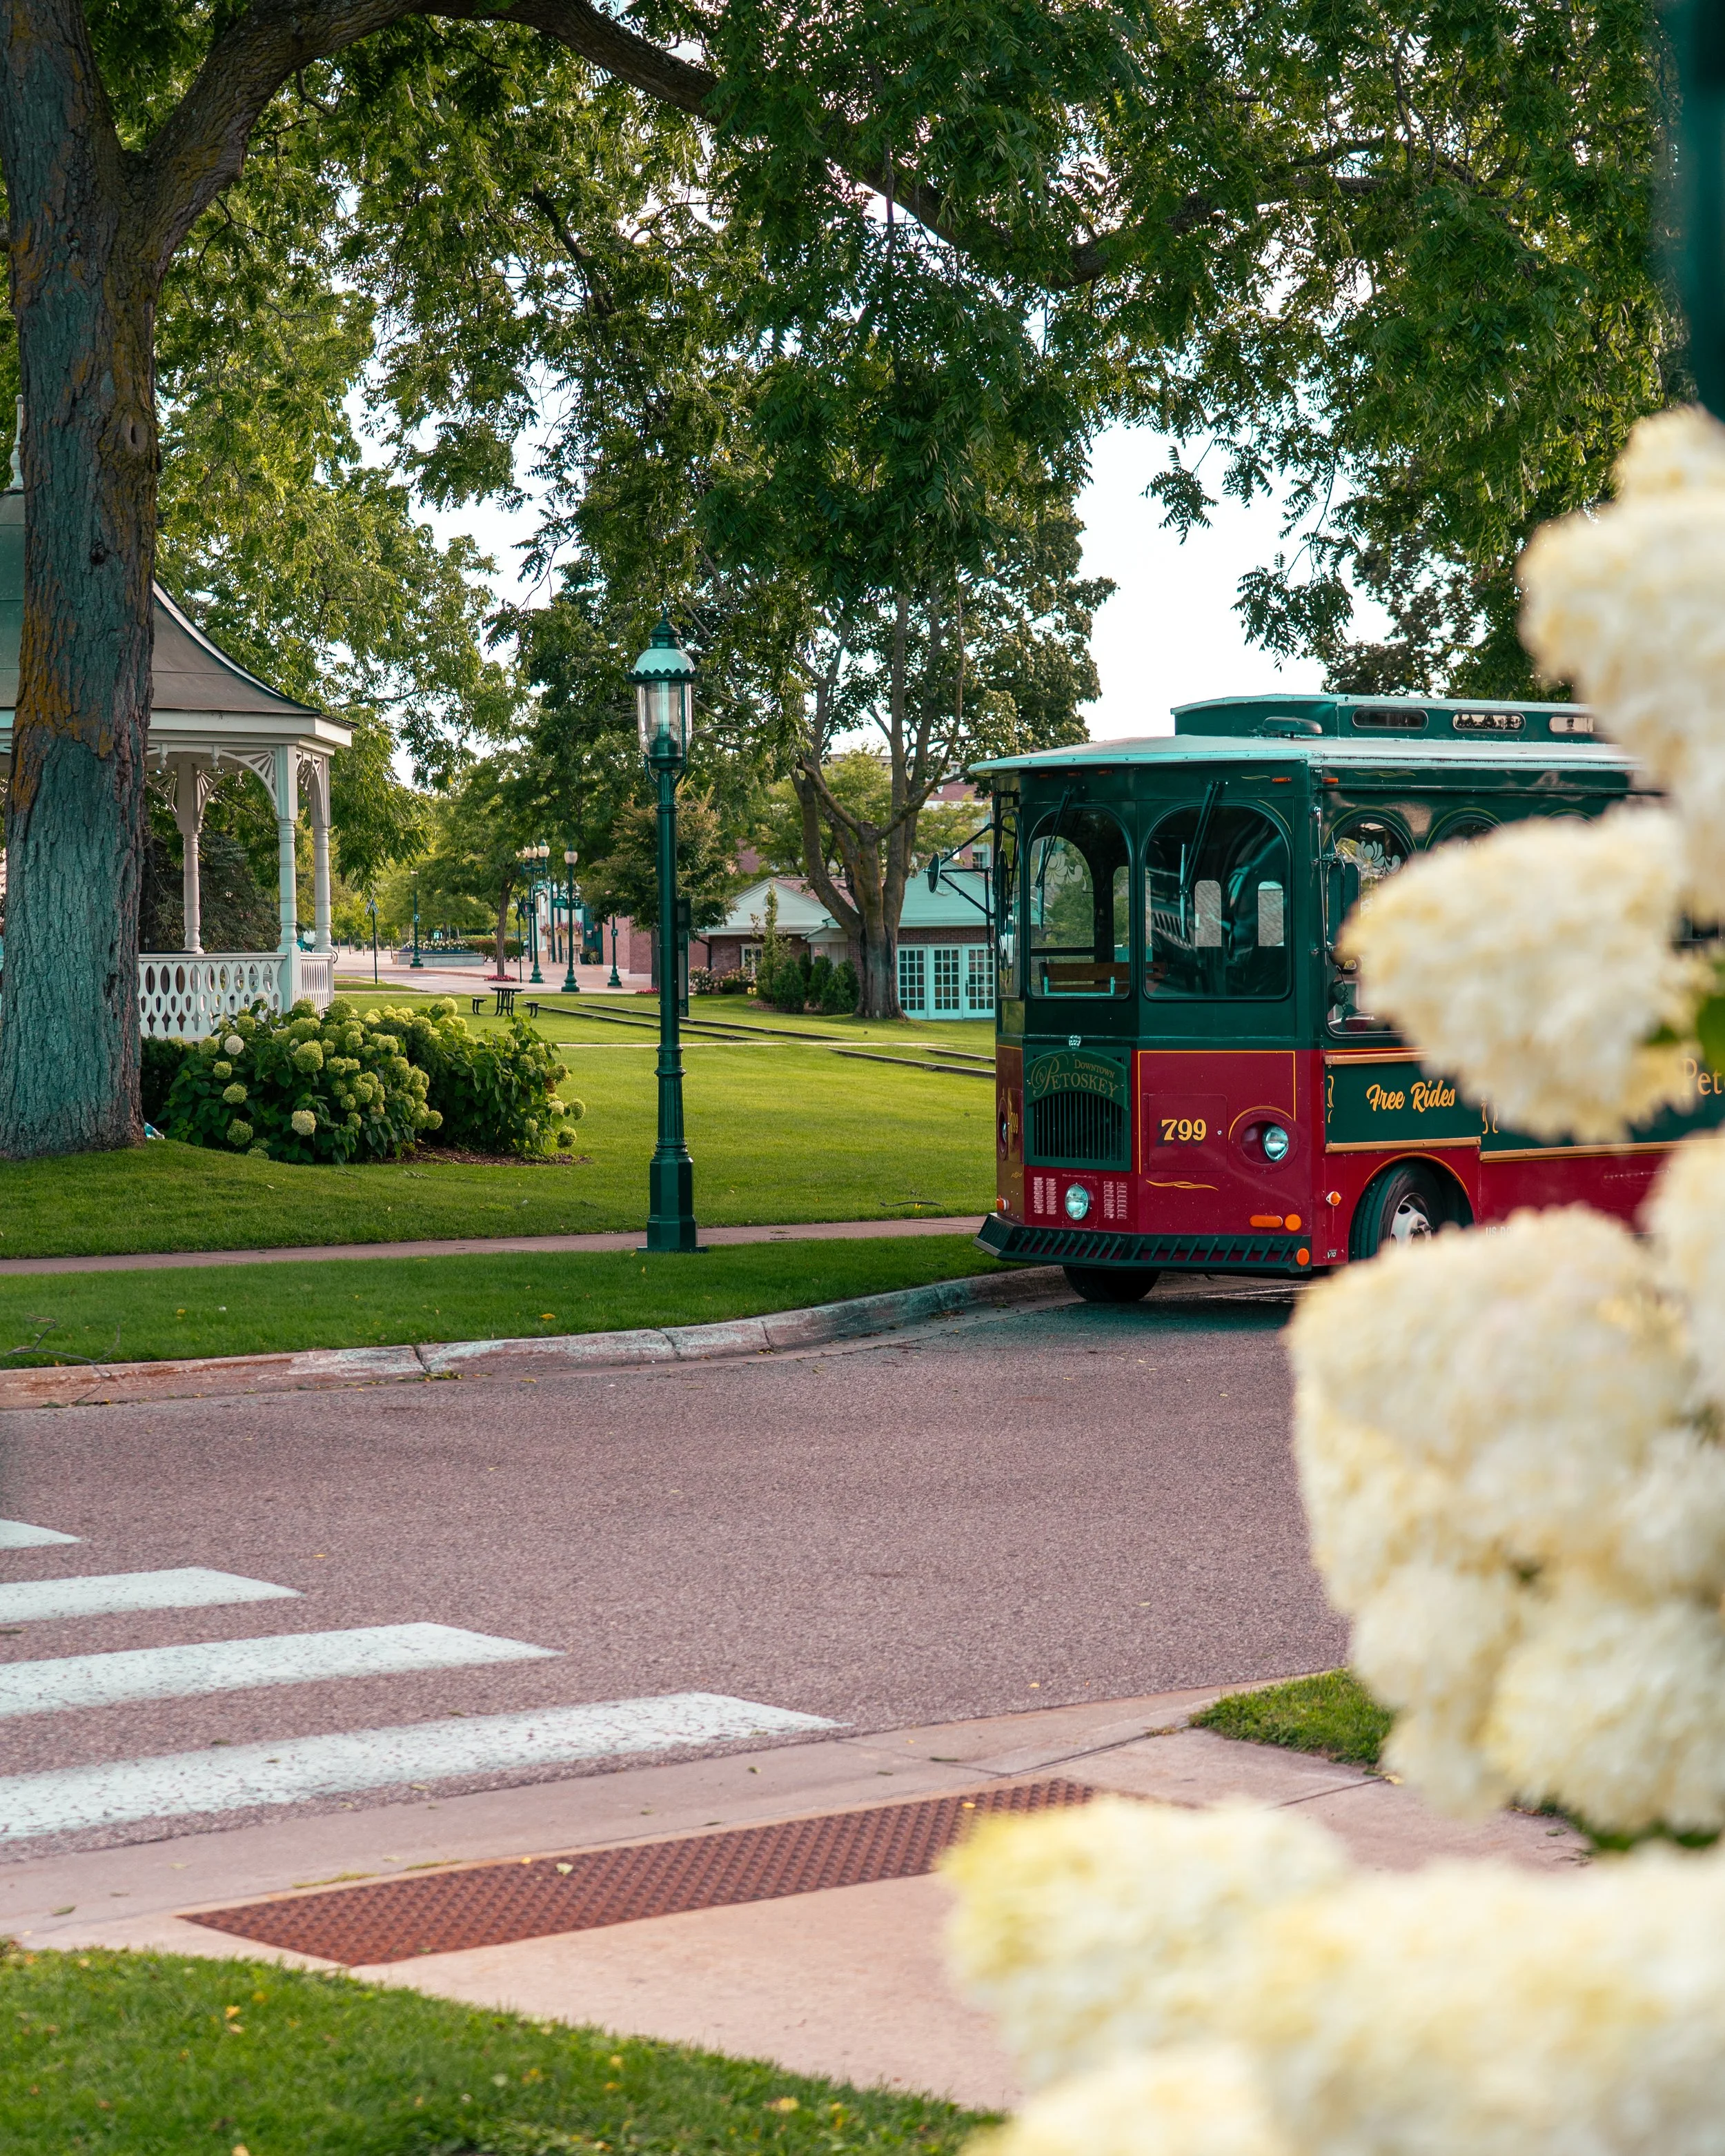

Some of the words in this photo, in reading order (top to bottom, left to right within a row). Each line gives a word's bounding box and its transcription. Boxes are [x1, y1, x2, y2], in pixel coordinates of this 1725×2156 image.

[1031, 1054, 1118, 1098] PETOSKEY
[1074, 1059, 1115, 1078] DOWNTOWN
[1681, 1057, 1725, 1096] Pet
[1366, 1084, 1405, 1111] Free
[1410, 1080, 1455, 1113] Rides
[1161, 1118, 1207, 1141] 799
